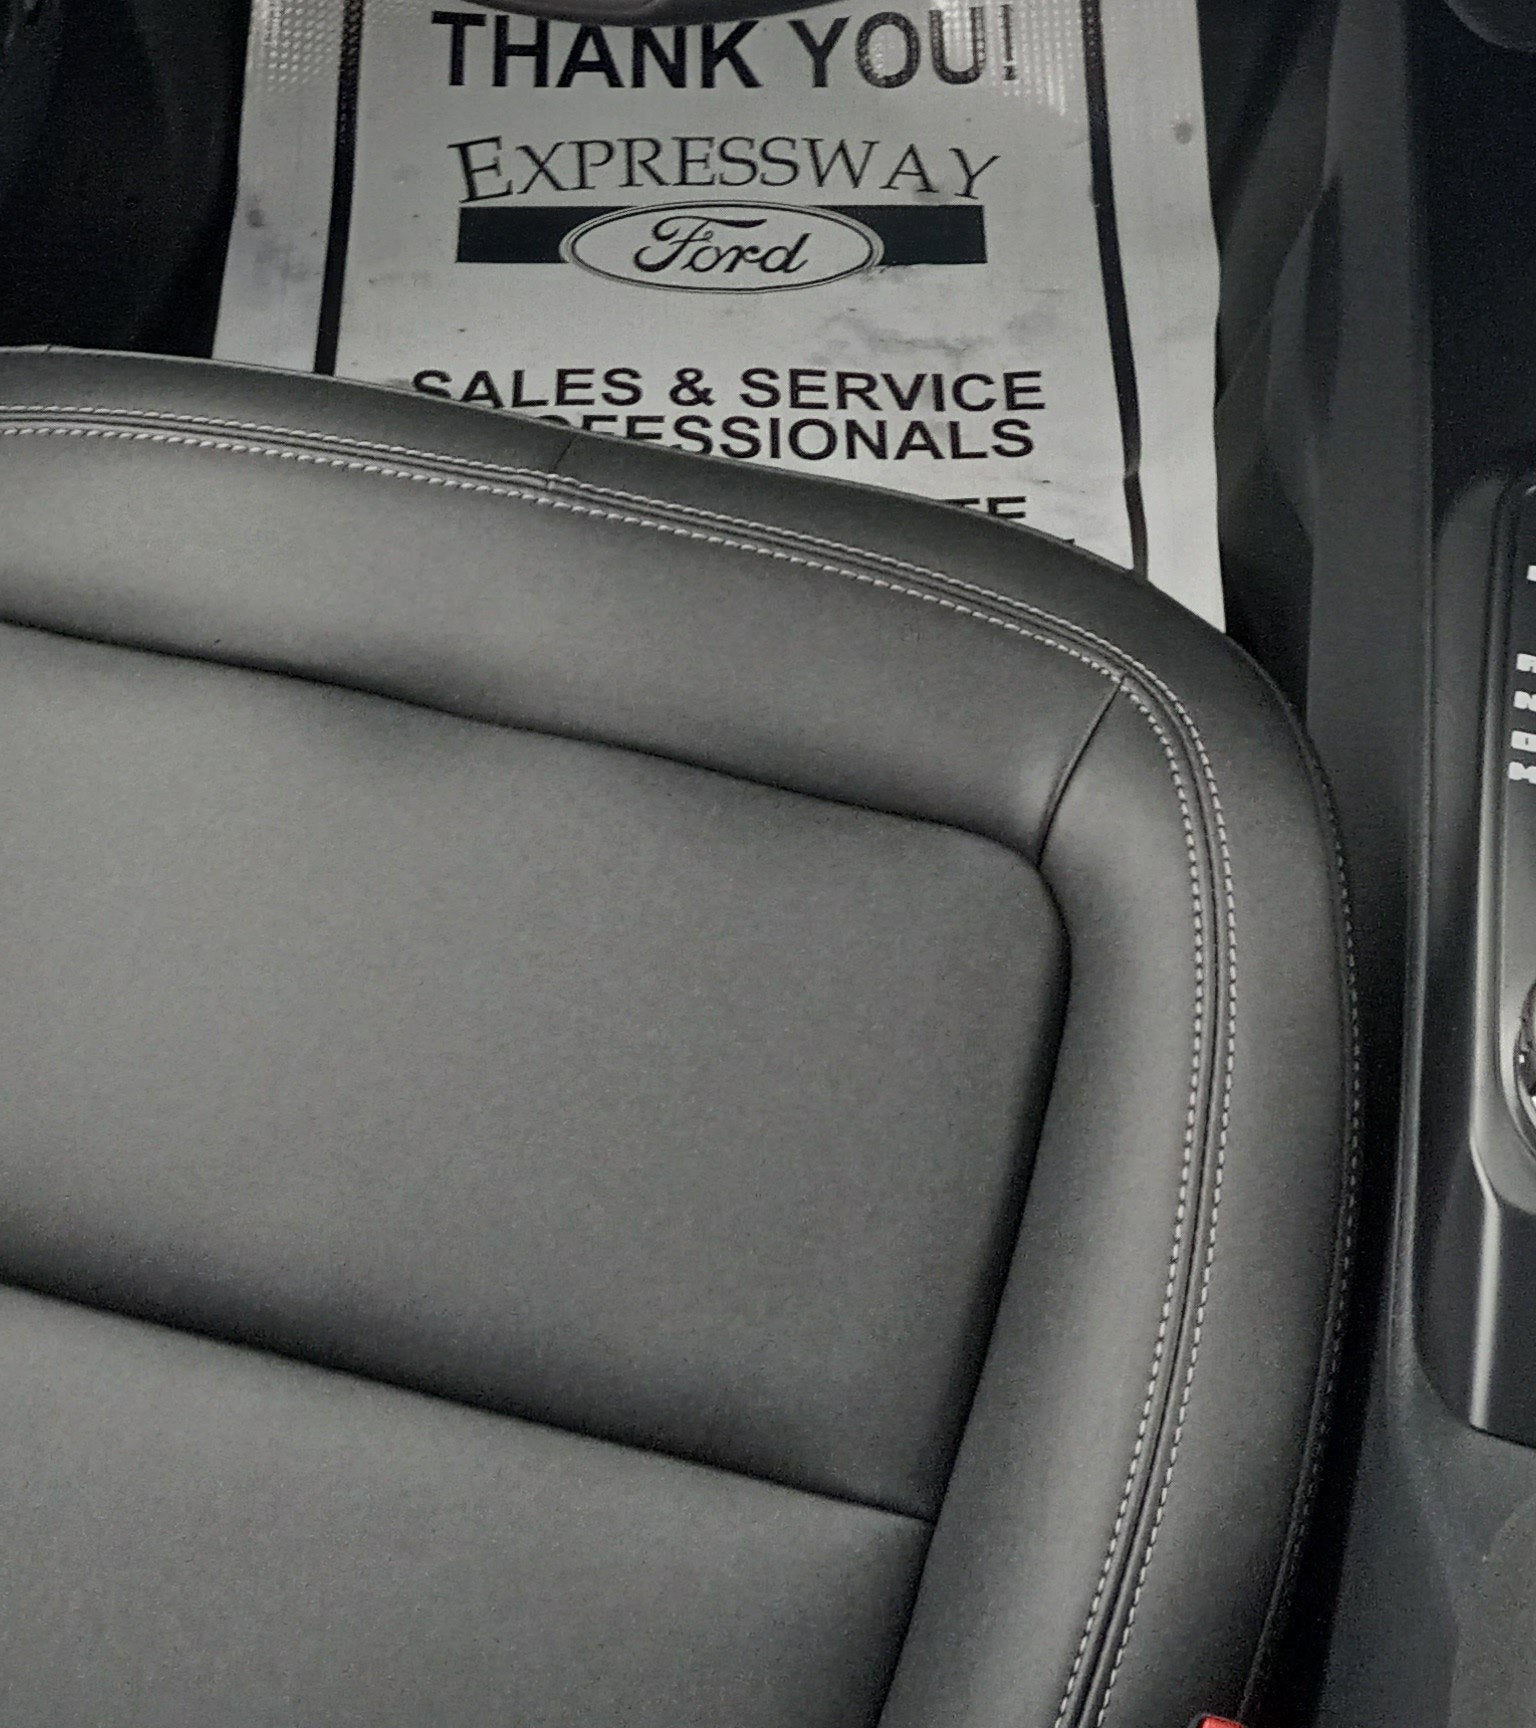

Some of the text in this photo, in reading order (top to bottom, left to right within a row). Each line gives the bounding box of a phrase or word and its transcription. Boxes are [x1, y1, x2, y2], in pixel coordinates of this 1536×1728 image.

[430, 3, 1018, 90] THANK YOU!
[446, 134, 1002, 203] EXPRESSWAY
[631, 215, 813, 277] Ford
[410, 366, 1047, 412] SALES & SERVICE
